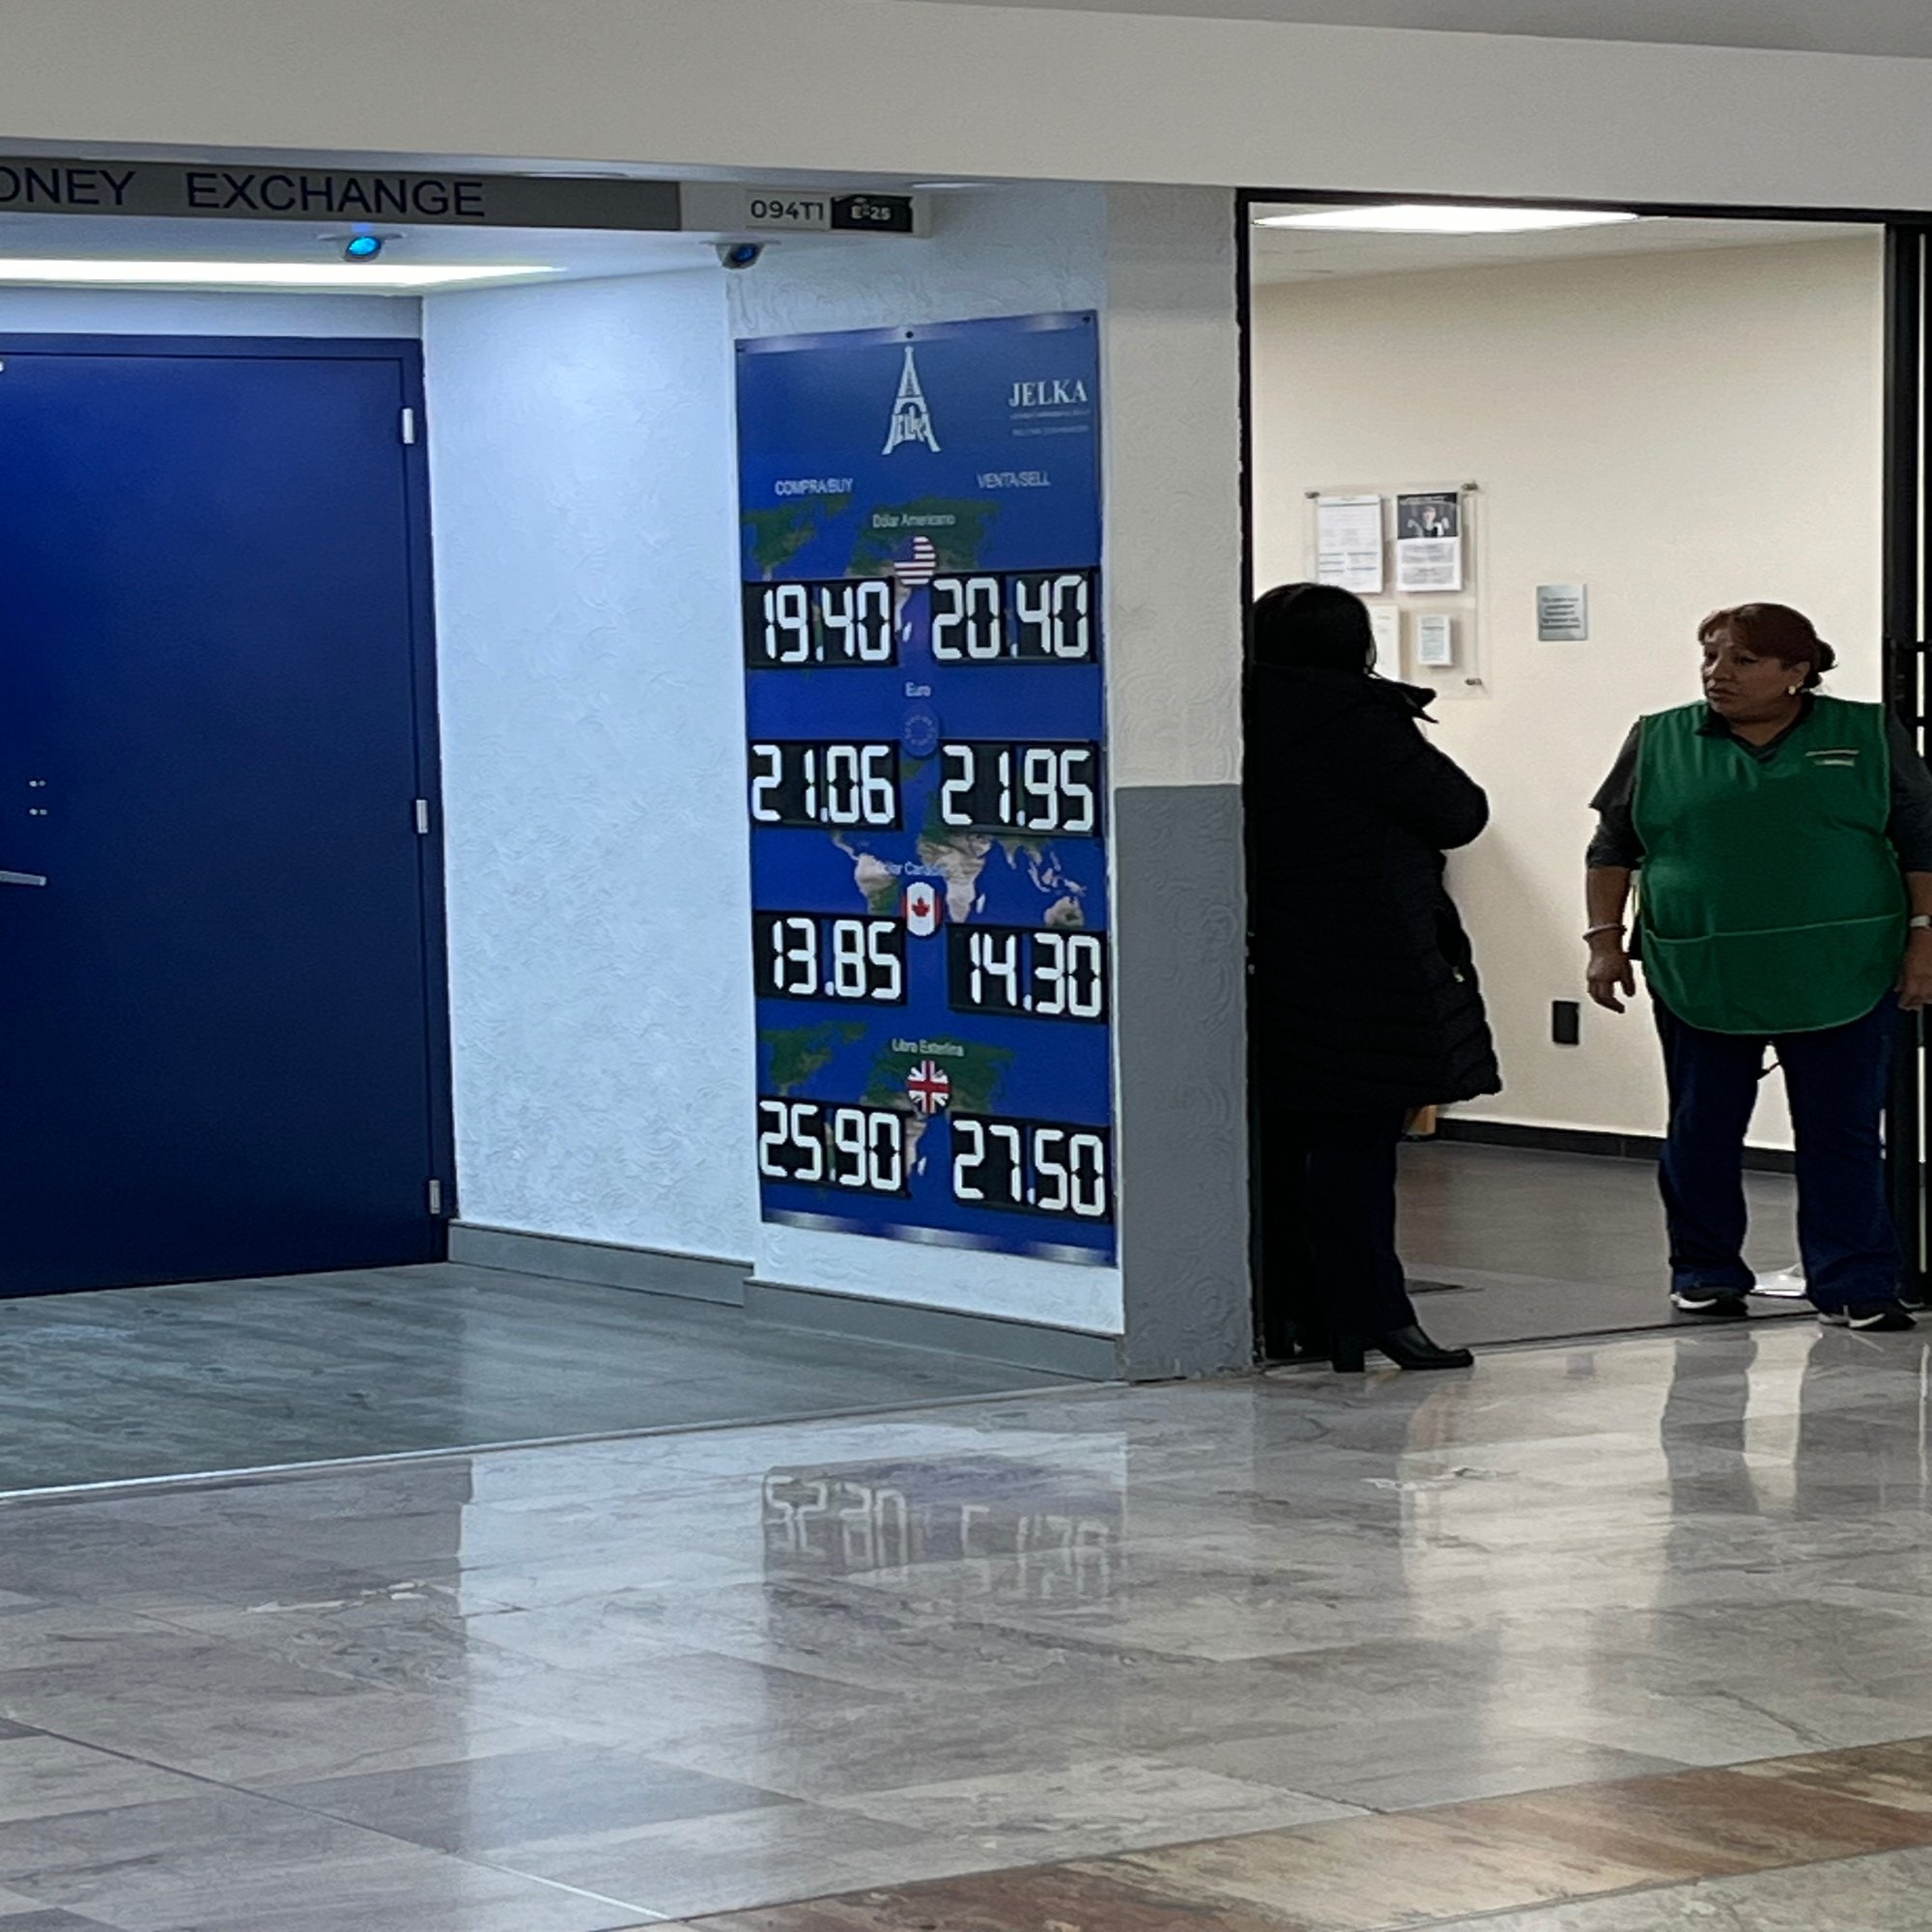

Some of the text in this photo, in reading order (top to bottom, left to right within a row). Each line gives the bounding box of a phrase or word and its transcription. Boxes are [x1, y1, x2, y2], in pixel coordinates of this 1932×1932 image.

[186, 171, 485, 217] EXCHANGE
[751, 199, 824, 221] 094T1
[1008, 379, 1089, 408] JELKA
[764, 581, 891, 663] 19.40
[932, 575, 1089, 660] 20.40
[904, 681, 932, 697] Euro
[752, 745, 895, 825] 21.06
[941, 745, 1094, 832] 21.95
[773, 918, 902, 1001] 13.85
[969, 931, 1102, 1018] 14.30
[759, 1100, 902, 1191] 25.90
[952, 1120, 1106, 1217] 27.50
